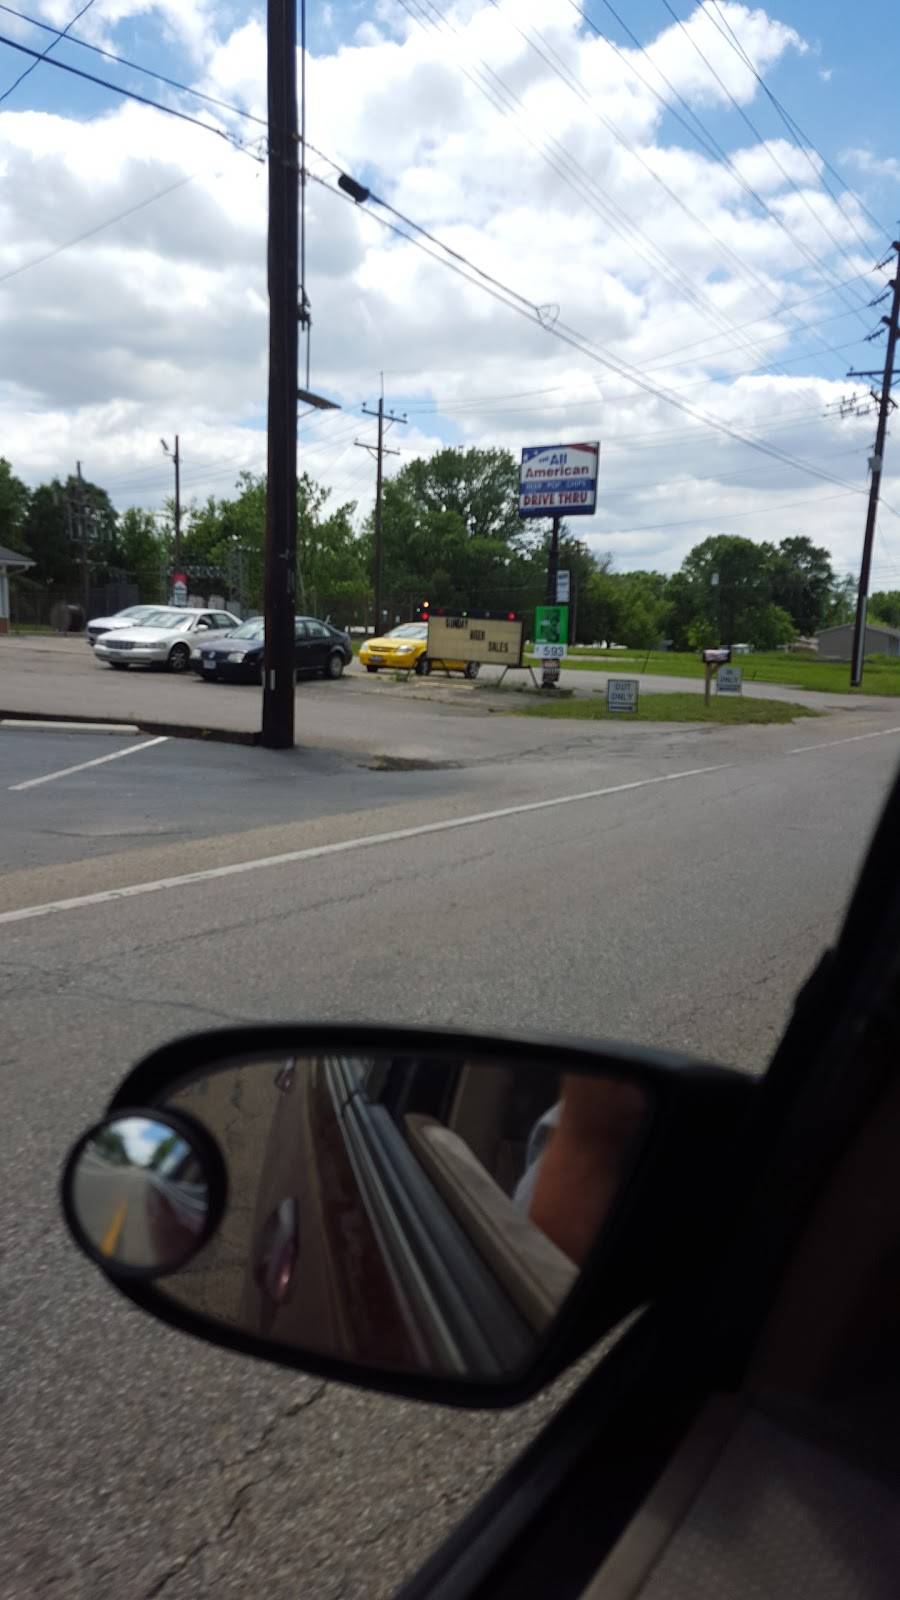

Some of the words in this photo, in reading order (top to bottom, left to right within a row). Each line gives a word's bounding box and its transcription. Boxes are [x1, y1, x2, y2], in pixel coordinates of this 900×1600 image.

[550, 453, 567, 465] All
[526, 465, 589, 478] American
[524, 493, 554, 506] DRIVE
[558, 491, 587, 505] THRU
[488, 641, 508, 653] SALES
[612, 692, 634, 701] ONLY
